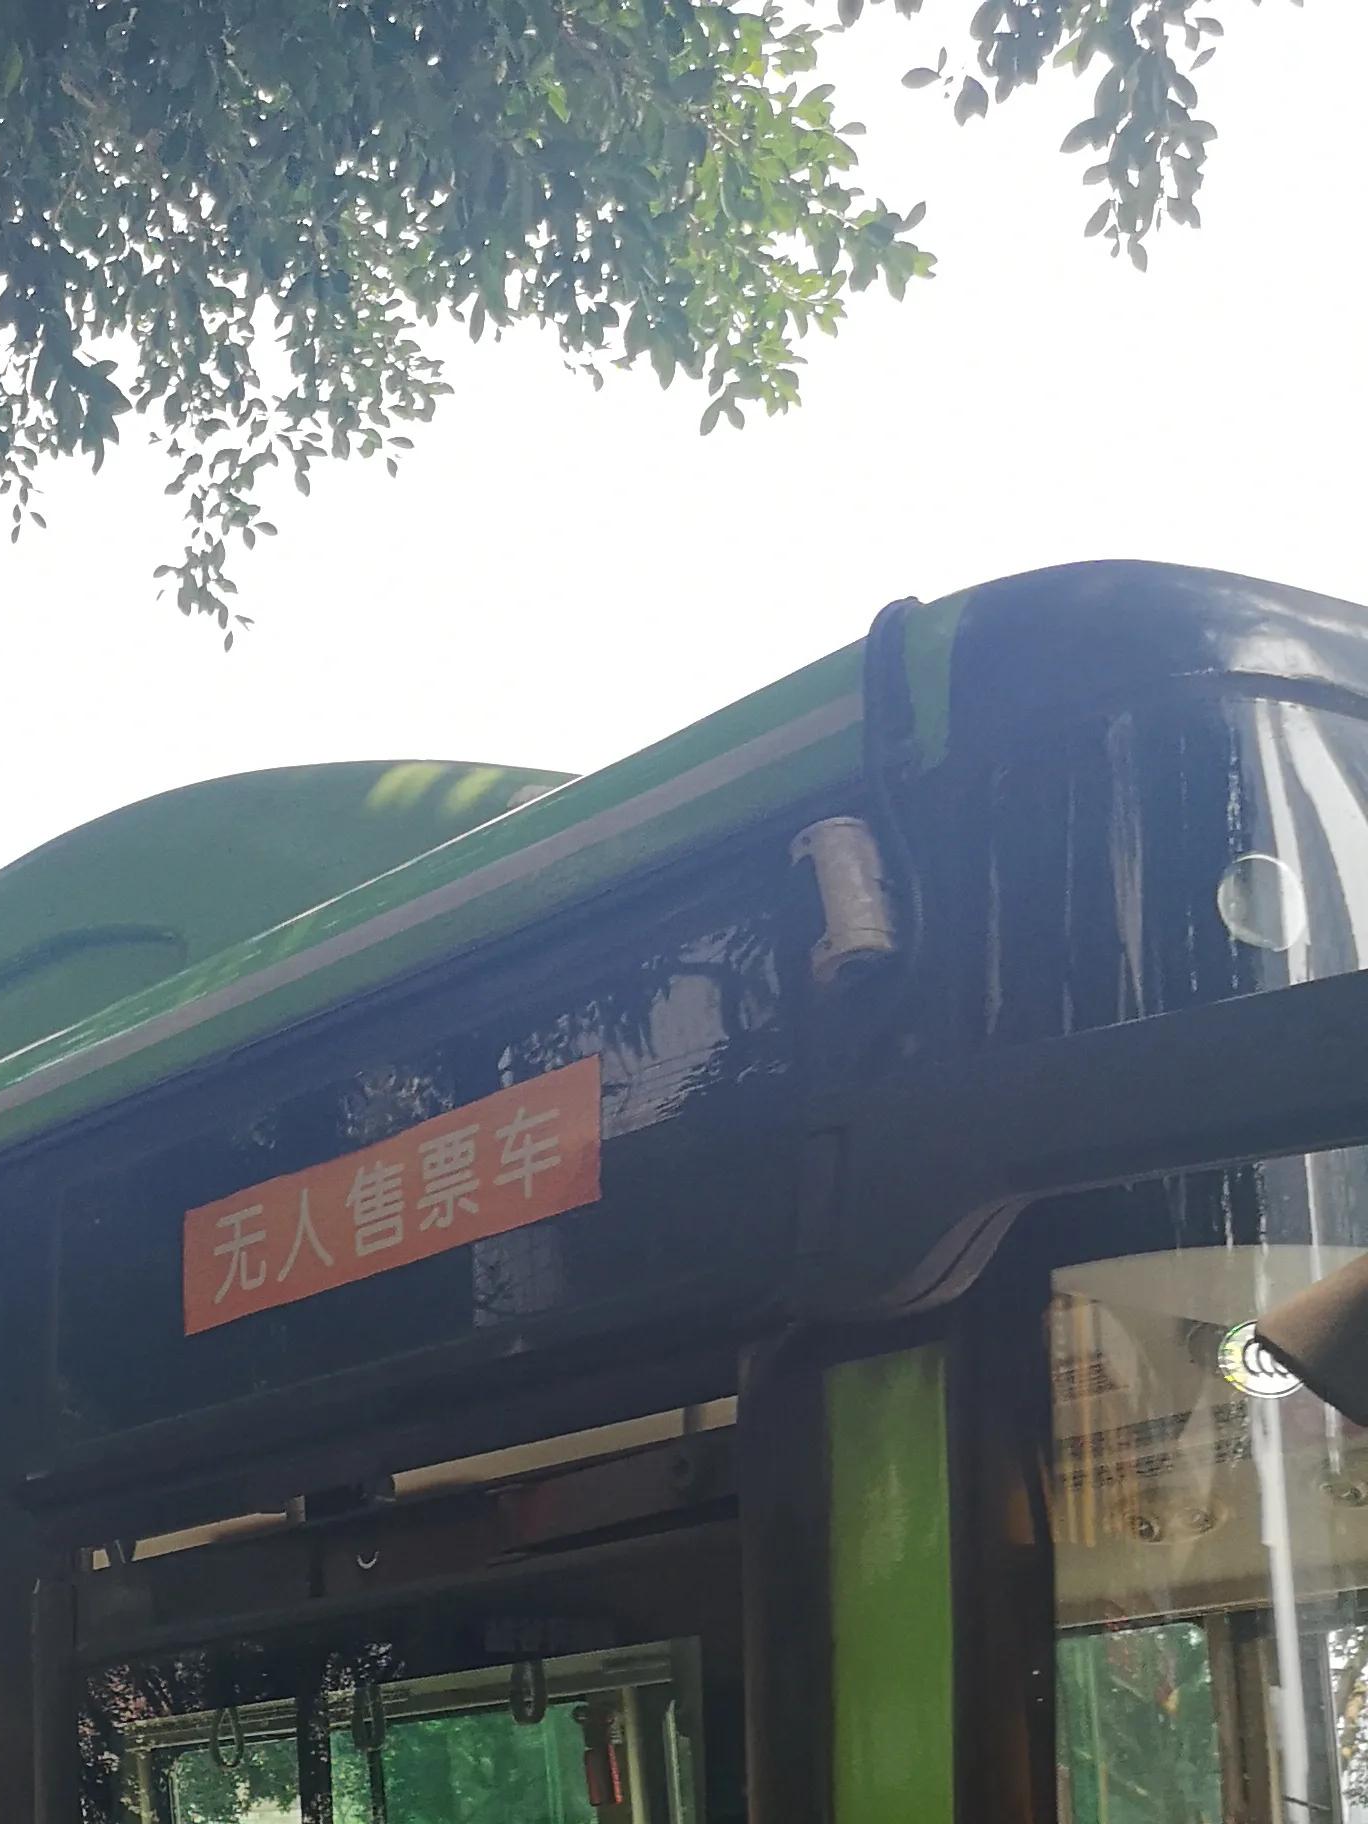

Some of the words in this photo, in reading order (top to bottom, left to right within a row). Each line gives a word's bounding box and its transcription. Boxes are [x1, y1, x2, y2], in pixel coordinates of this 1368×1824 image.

[213, 1105, 562, 1305] 无人售票车
